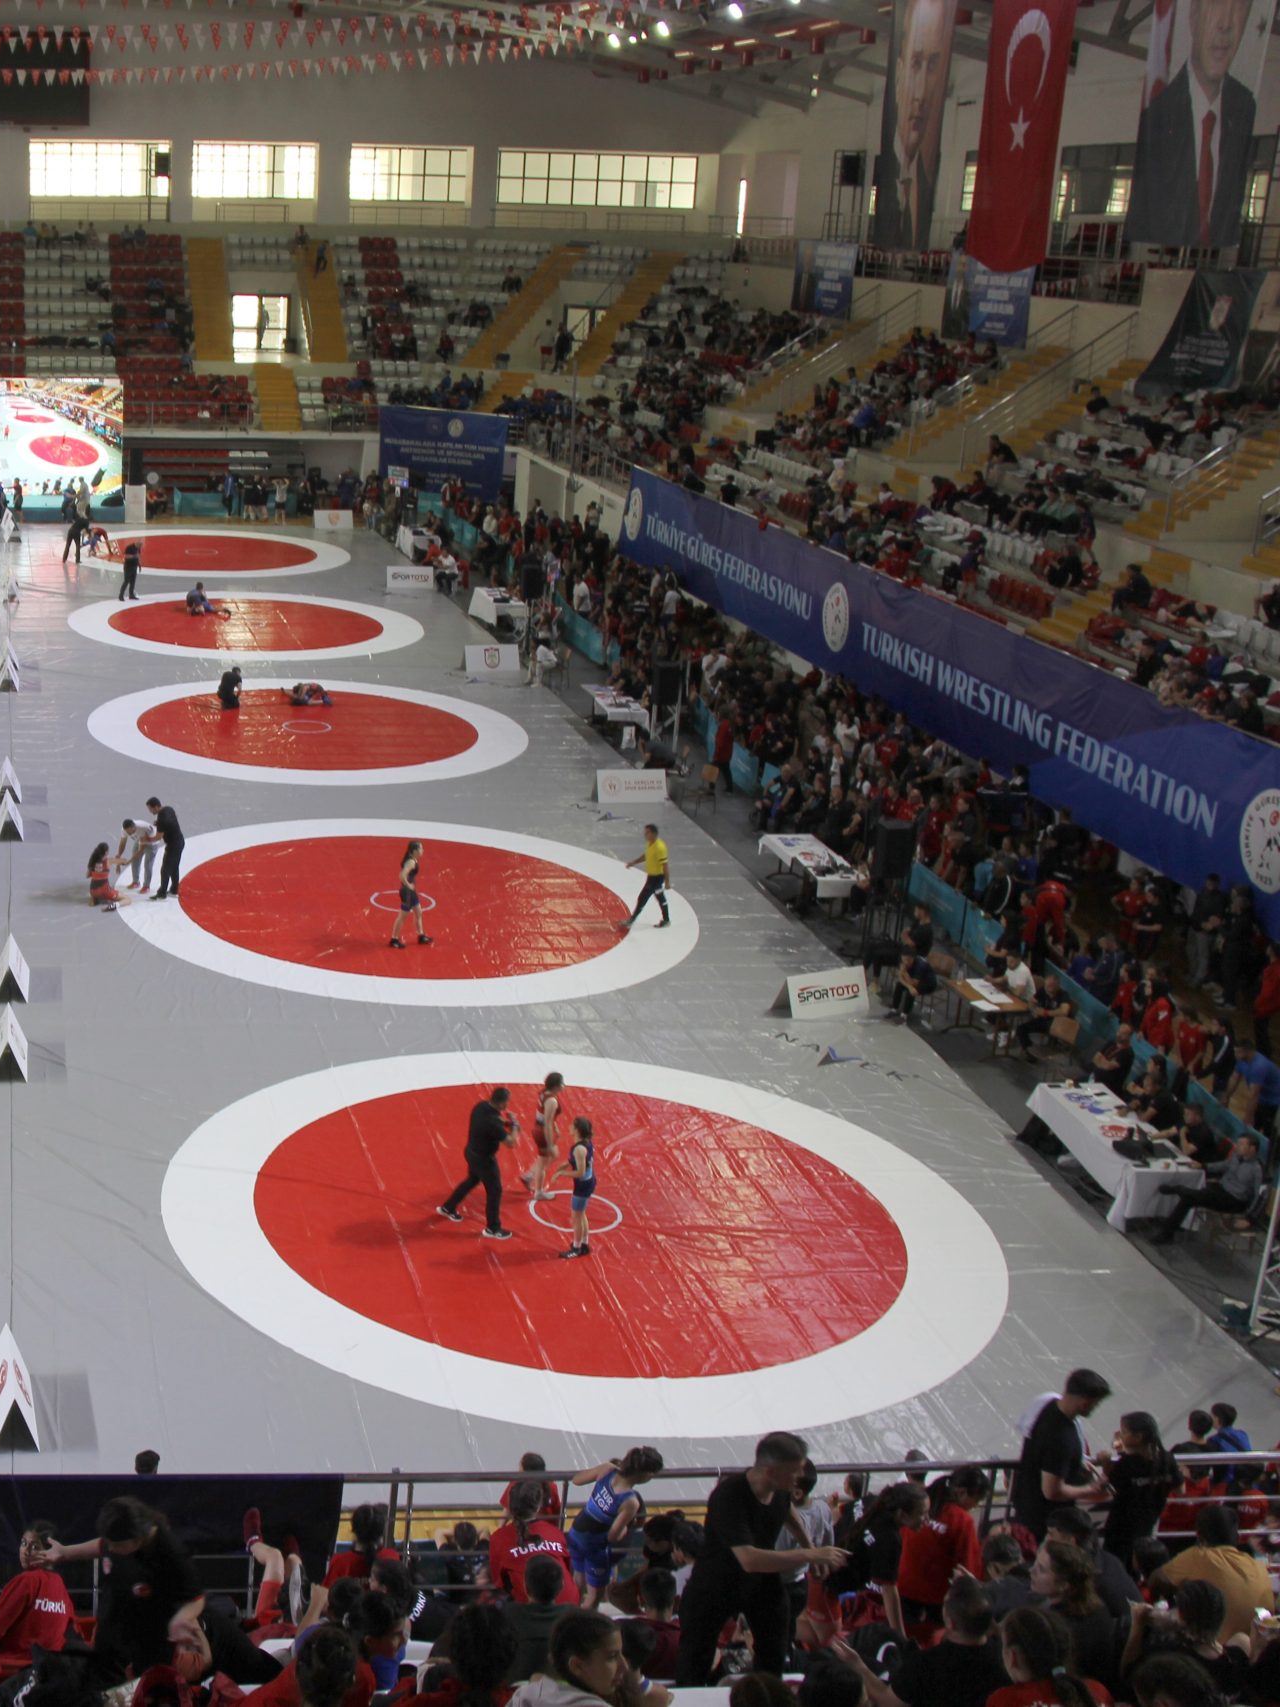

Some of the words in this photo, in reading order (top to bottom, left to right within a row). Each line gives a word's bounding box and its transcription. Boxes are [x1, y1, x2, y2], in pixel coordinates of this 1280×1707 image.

[646, 512, 686, 555] TÜRKİYE
[687, 533, 722, 578] GÜREŞ
[722, 552, 813, 620] FEDERASYONU
[862, 621, 934, 687] TURKISH
[936, 658, 1053, 750] WRESTLING
[1054, 720, 1219, 839] FEDERATION
[797, 983, 860, 1003] SPORTOTO
[34, 1598, 66, 1615] TÜRKİ
[409, 1591, 426, 1622] TÜRKİ
